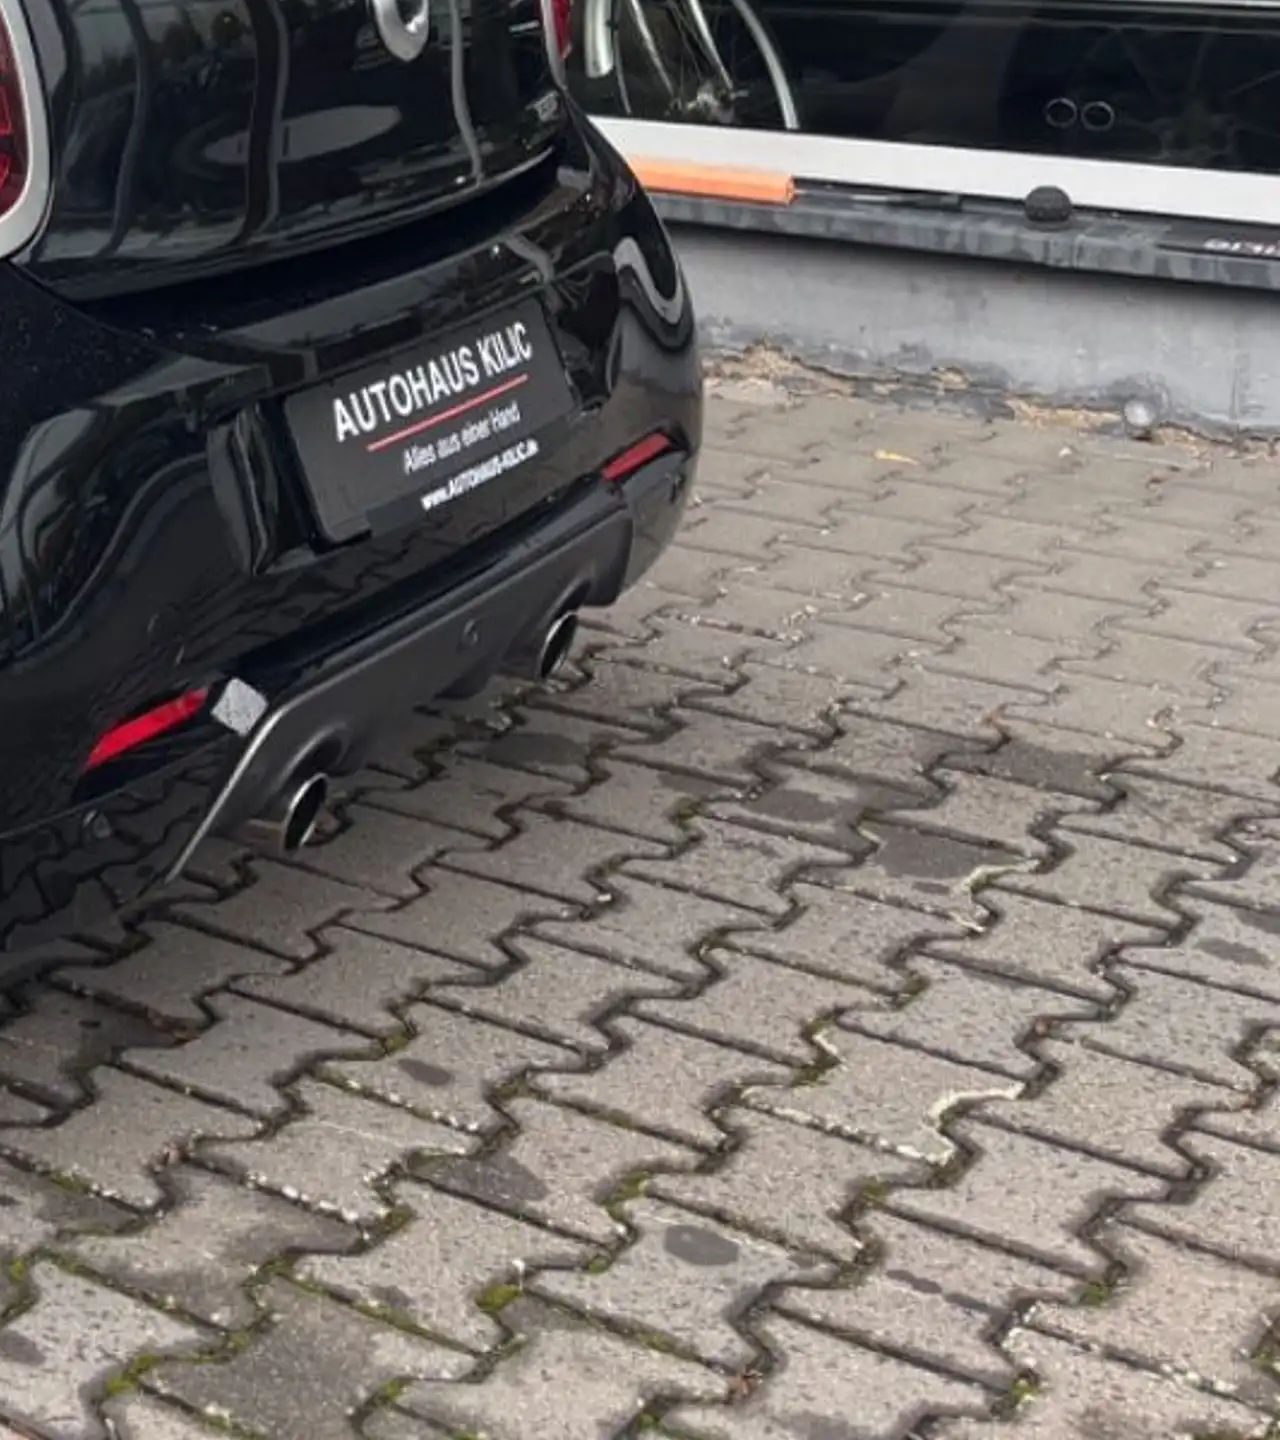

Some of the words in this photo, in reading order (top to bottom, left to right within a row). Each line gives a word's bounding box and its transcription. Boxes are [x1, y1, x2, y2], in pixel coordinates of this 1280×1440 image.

[332, 345, 481, 442] AUTOHAUS
[475, 321, 533, 378] KILIC
[403, 442, 437, 476] Alles
[436, 430, 462, 460] aus
[461, 417, 492, 448] einer
[488, 399, 522, 433] Hand
